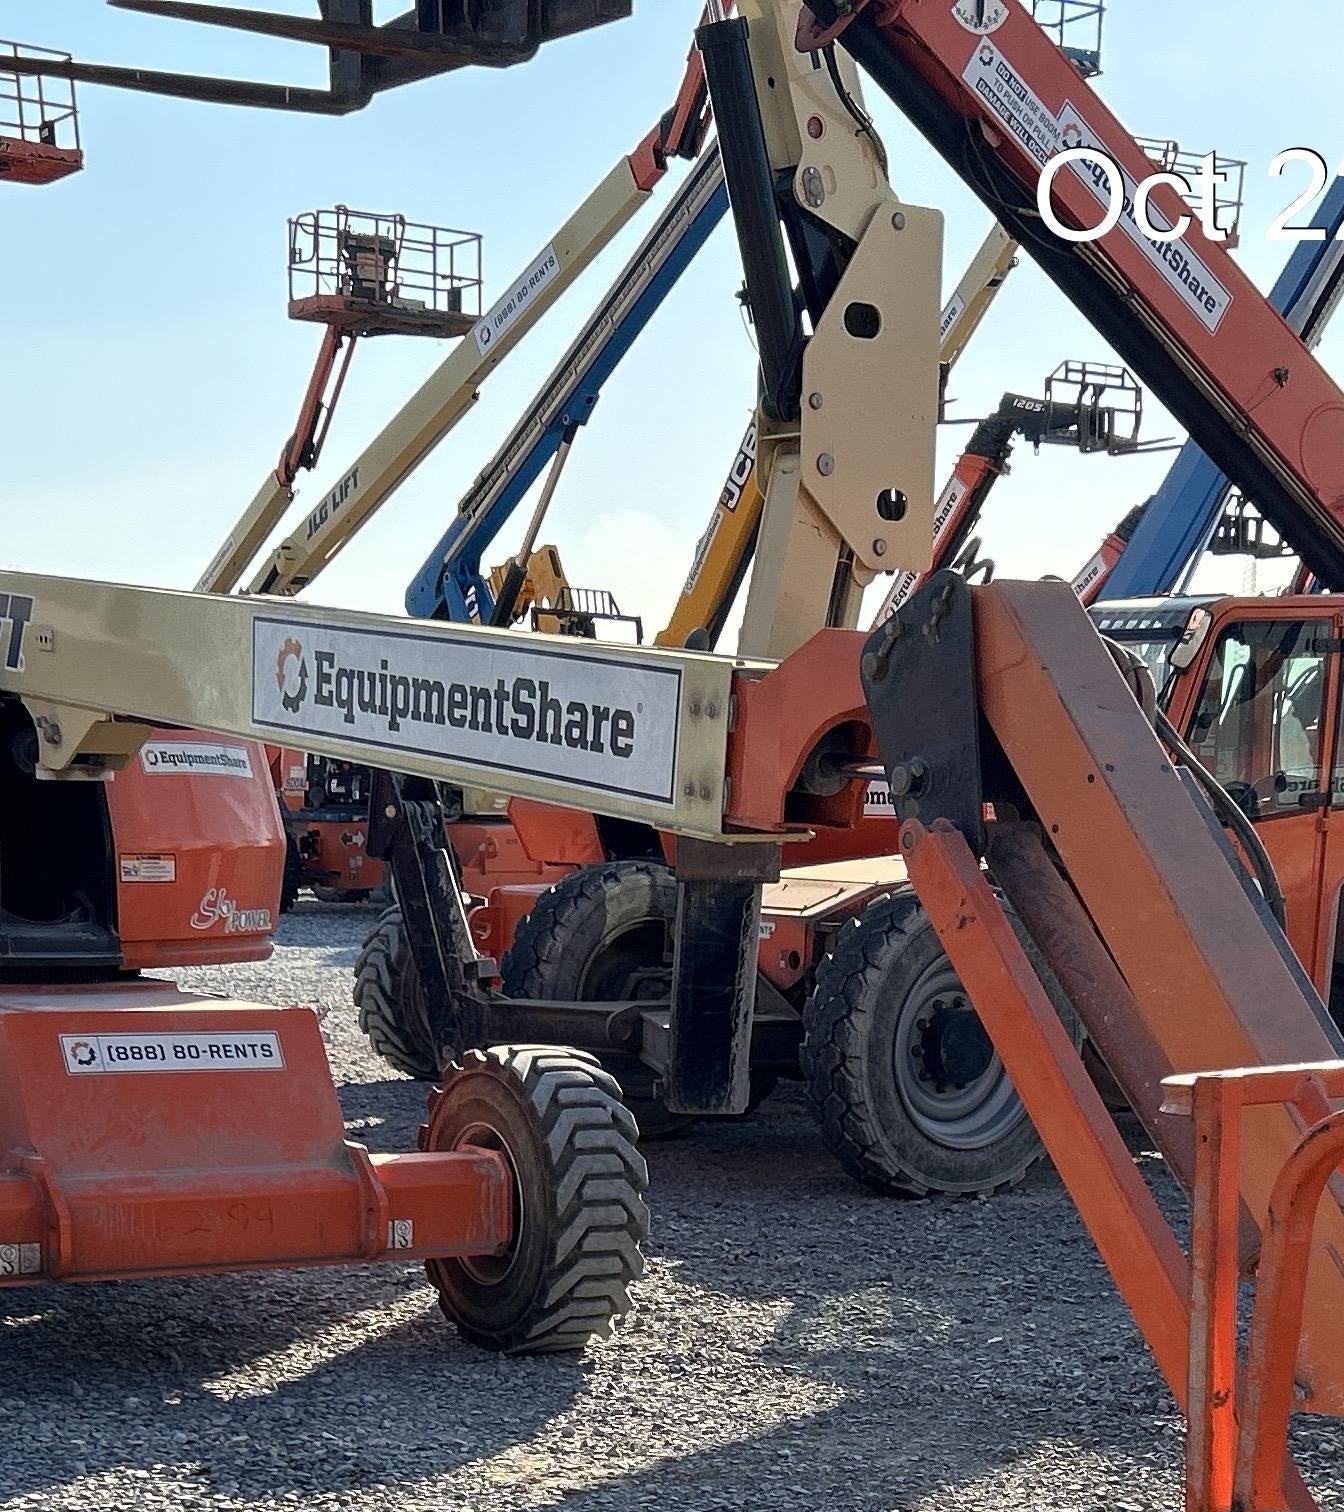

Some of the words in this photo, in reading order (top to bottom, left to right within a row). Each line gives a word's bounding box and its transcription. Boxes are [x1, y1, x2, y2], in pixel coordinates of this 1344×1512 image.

[978, 80, 1010, 121] DAMAGE
[1010, 117, 1028, 142] WILL
[993, 78, 1003, 93] TO
[1003, 91, 1023, 116] PUSH
[1022, 112, 1033, 128] OR
[1033, 125, 1051, 150] PULL
[997, 63, 1010, 79] DO
[1010, 76, 1027, 99] NOT
[1024, 94, 1041, 114] USE
[1039, 111, 1061, 141] BOOM
[307, 507, 329, 540] JLG
[332, 467, 360, 513] LIFT
[314, 649, 635, 758] EquipmentShare
[161, 750, 248, 770] EquipmentShare
[230, 909, 272, 934] POWER
[106, 1045, 167, 1062] (888)
[173, 1043, 274, 1060] 80-RENTS
